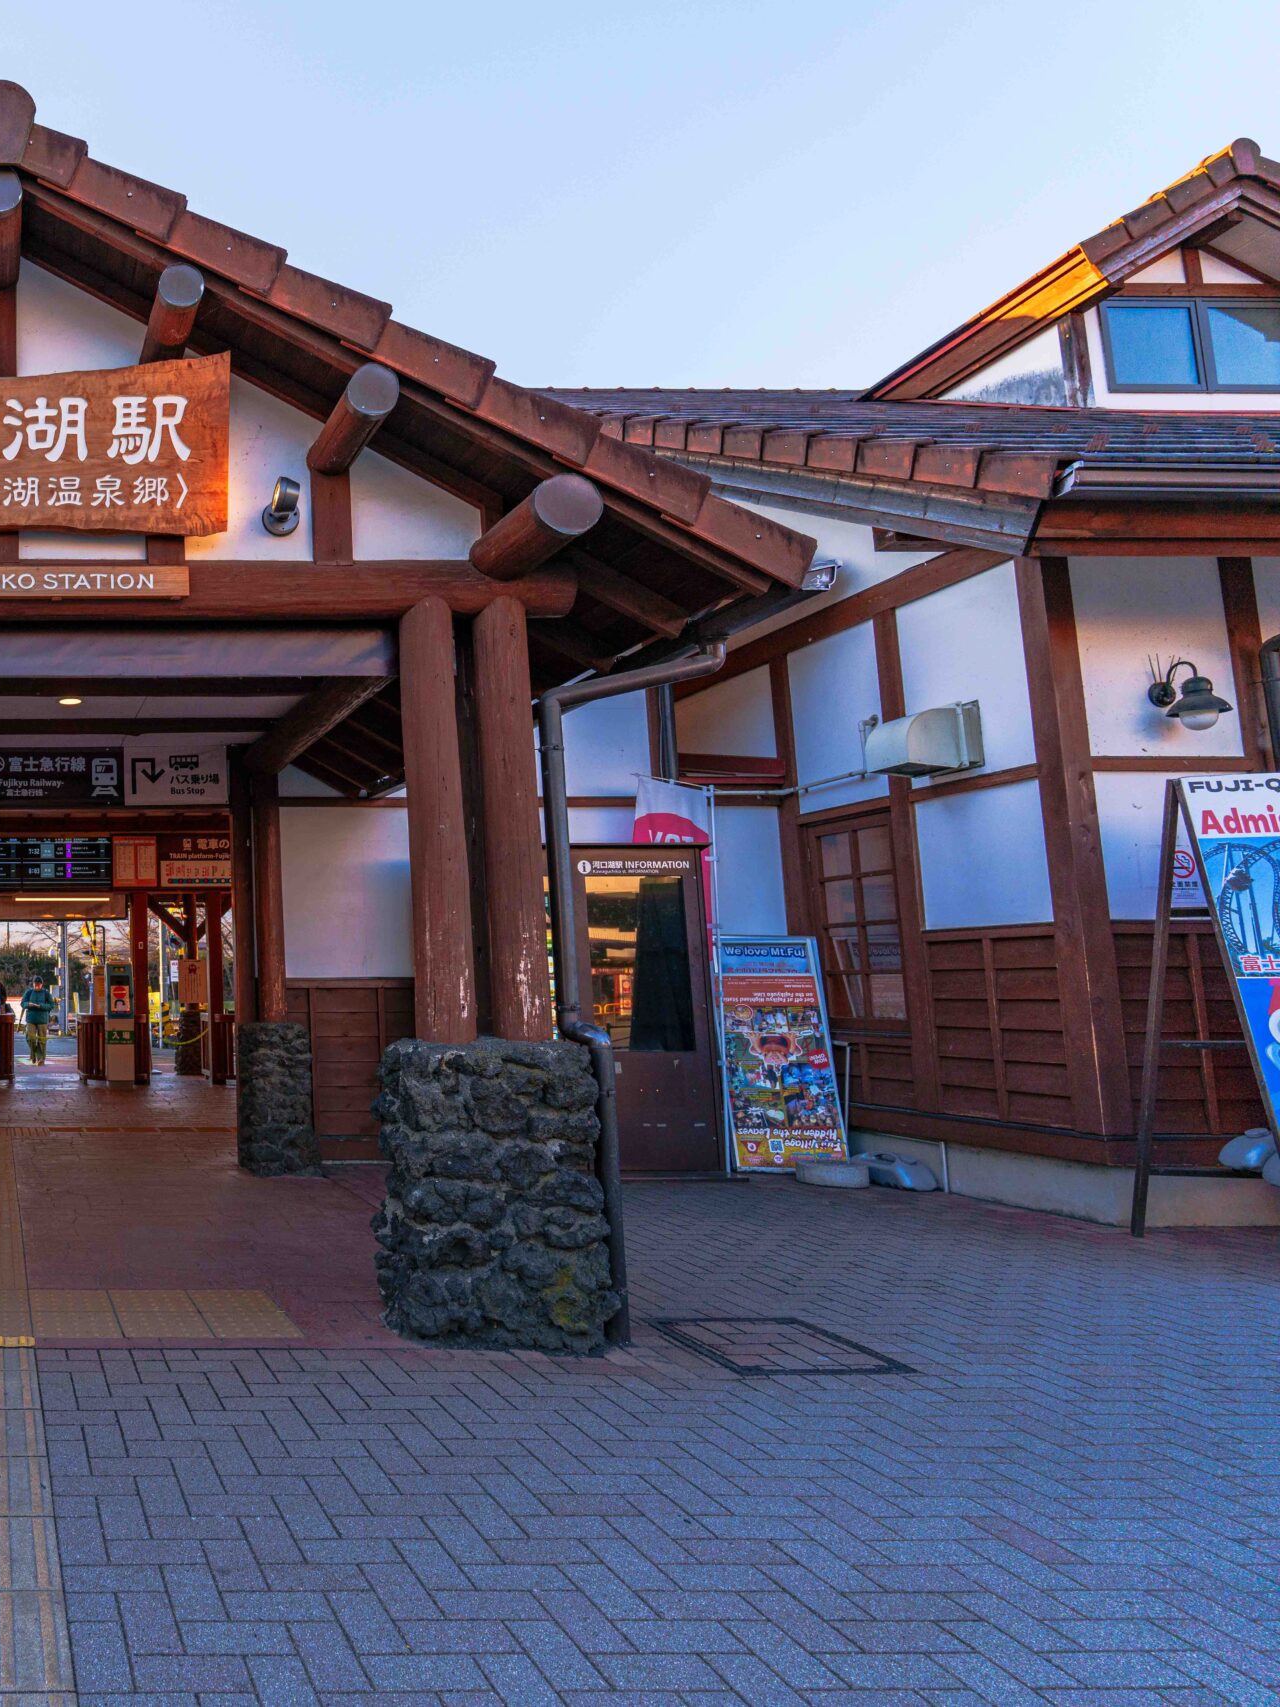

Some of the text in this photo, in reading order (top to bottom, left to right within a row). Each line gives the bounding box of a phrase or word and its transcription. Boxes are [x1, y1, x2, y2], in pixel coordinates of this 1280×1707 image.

[42, 572, 156, 591] STATION
[8, 756, 86, 772] 富士急行線
[170, 773, 220, 785] バス乗り場
[186, 786, 206, 796] Stop
[1188, 778, 1280, 793] FUJI-Q
[1201, 804, 1280, 835] Admi
[592, 860, 690, 869] 河口湖駅 INFORMATION
[724, 946, 742, 956] We
[744, 946, 768, 956] love
[1240, 954, 1280, 972] 富士
[737, 1128, 837, 1140] Hidden in the Leaves
[784, 1139, 819, 1150] Village
